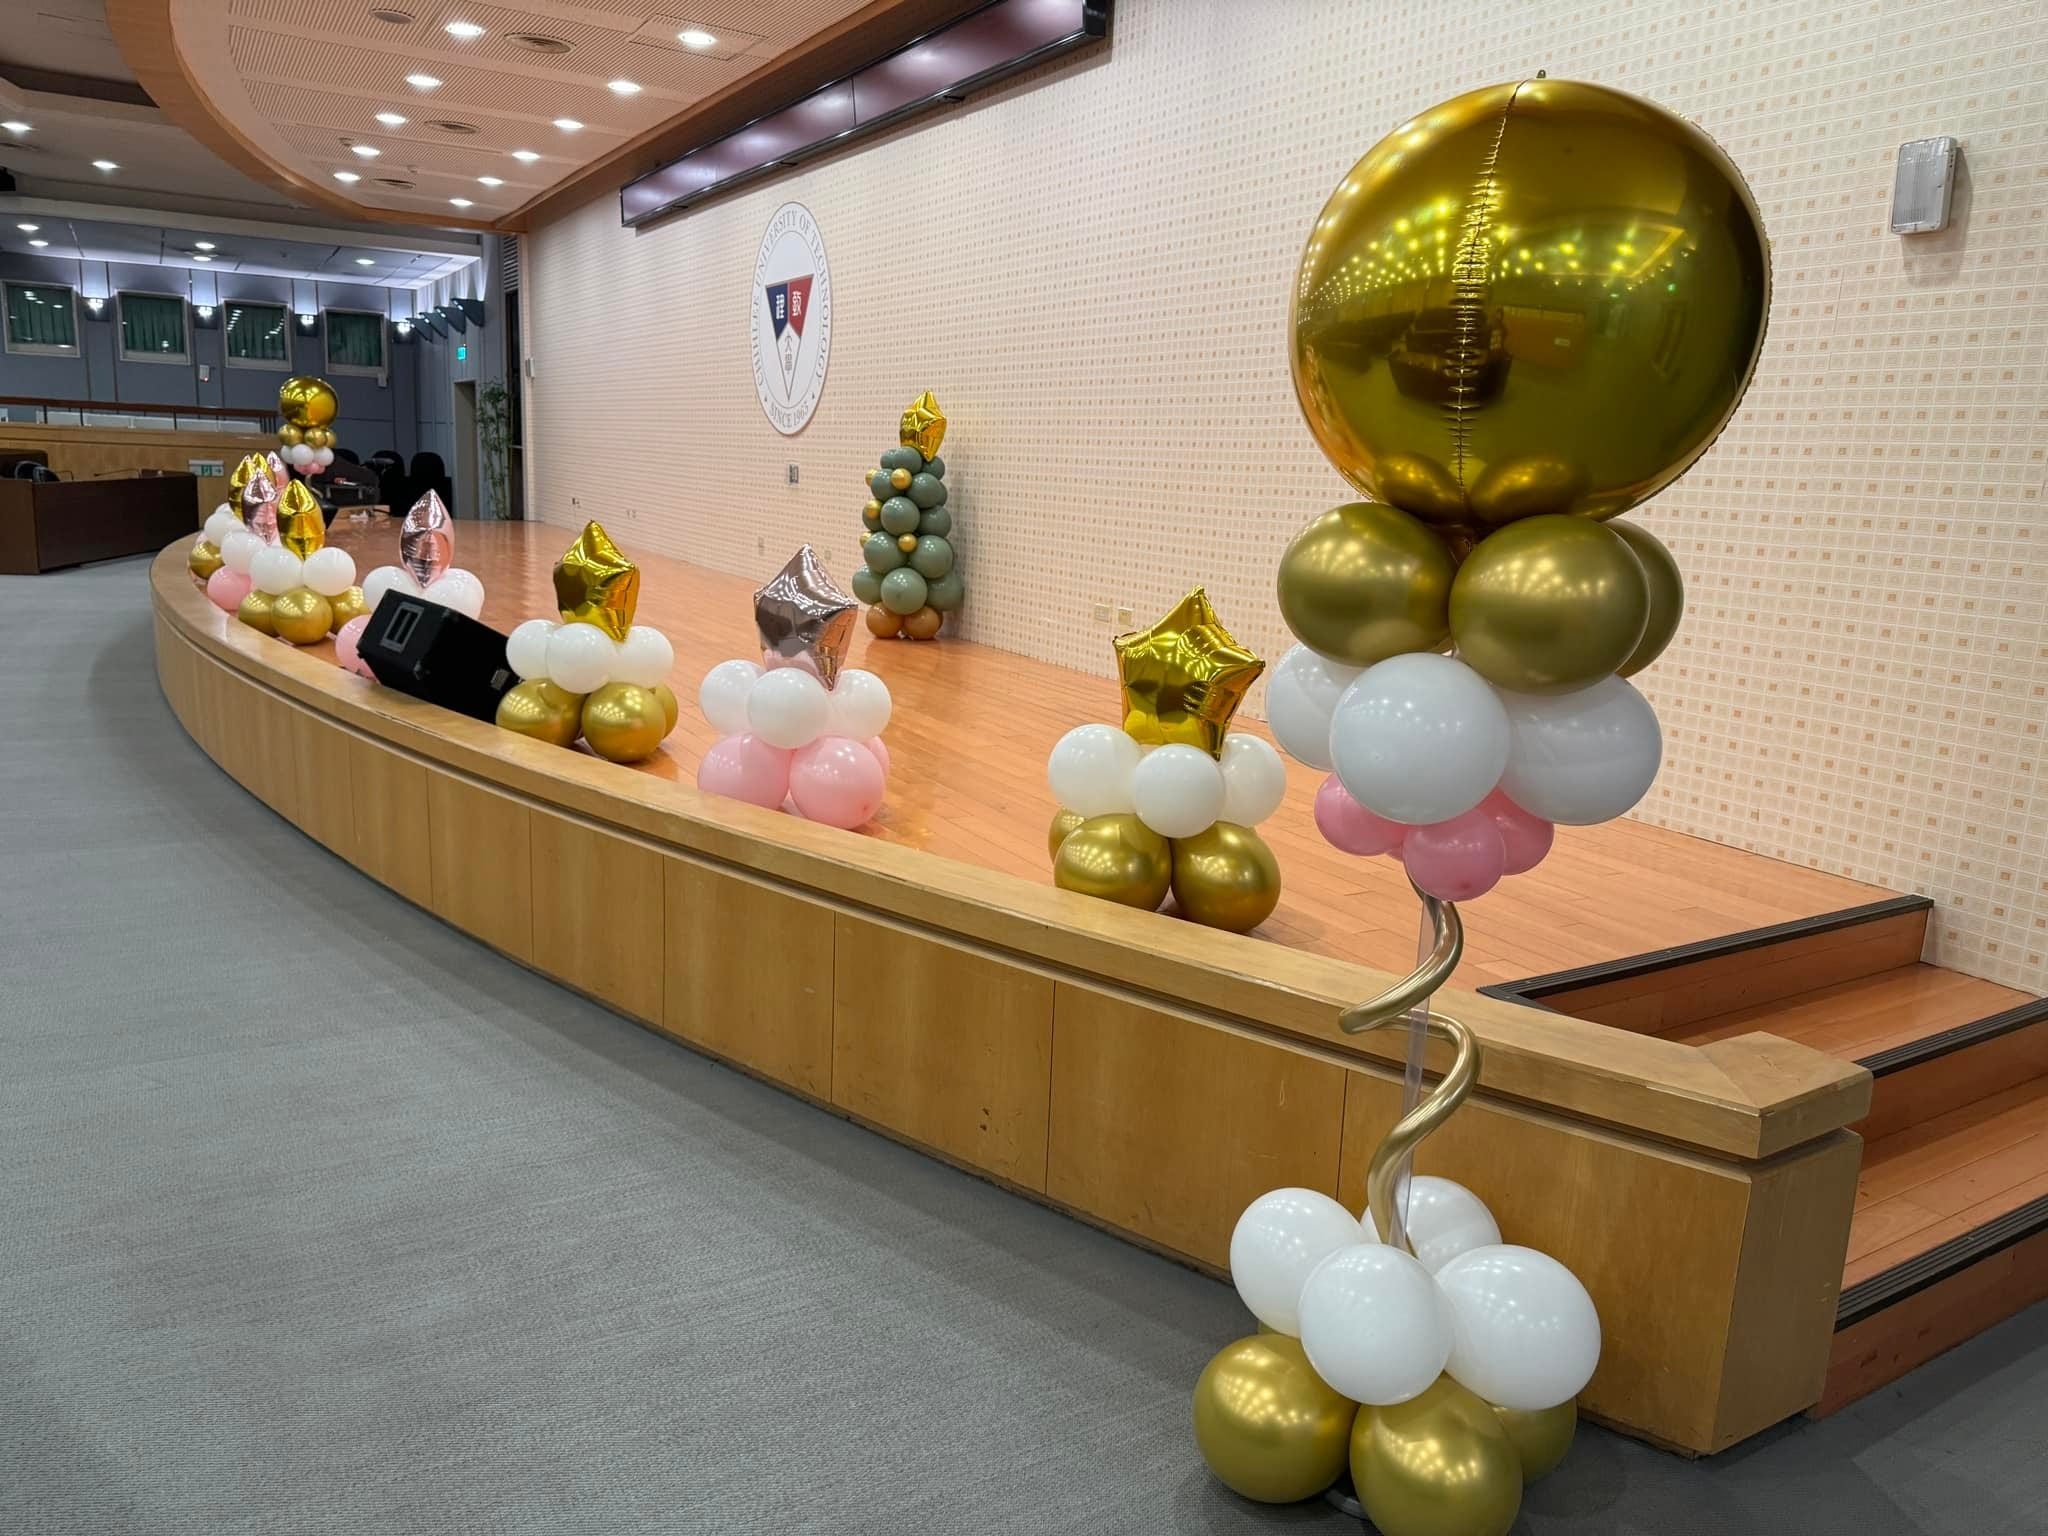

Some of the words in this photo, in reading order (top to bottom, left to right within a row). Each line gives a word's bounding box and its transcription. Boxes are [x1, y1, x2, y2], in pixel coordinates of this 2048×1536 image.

[755, 210, 798, 288] UNIVERSITY
[799, 214, 811, 235] OF
[811, 229, 829, 387] TECHNOLOGY
[769, 402, 793, 428] SINCE
